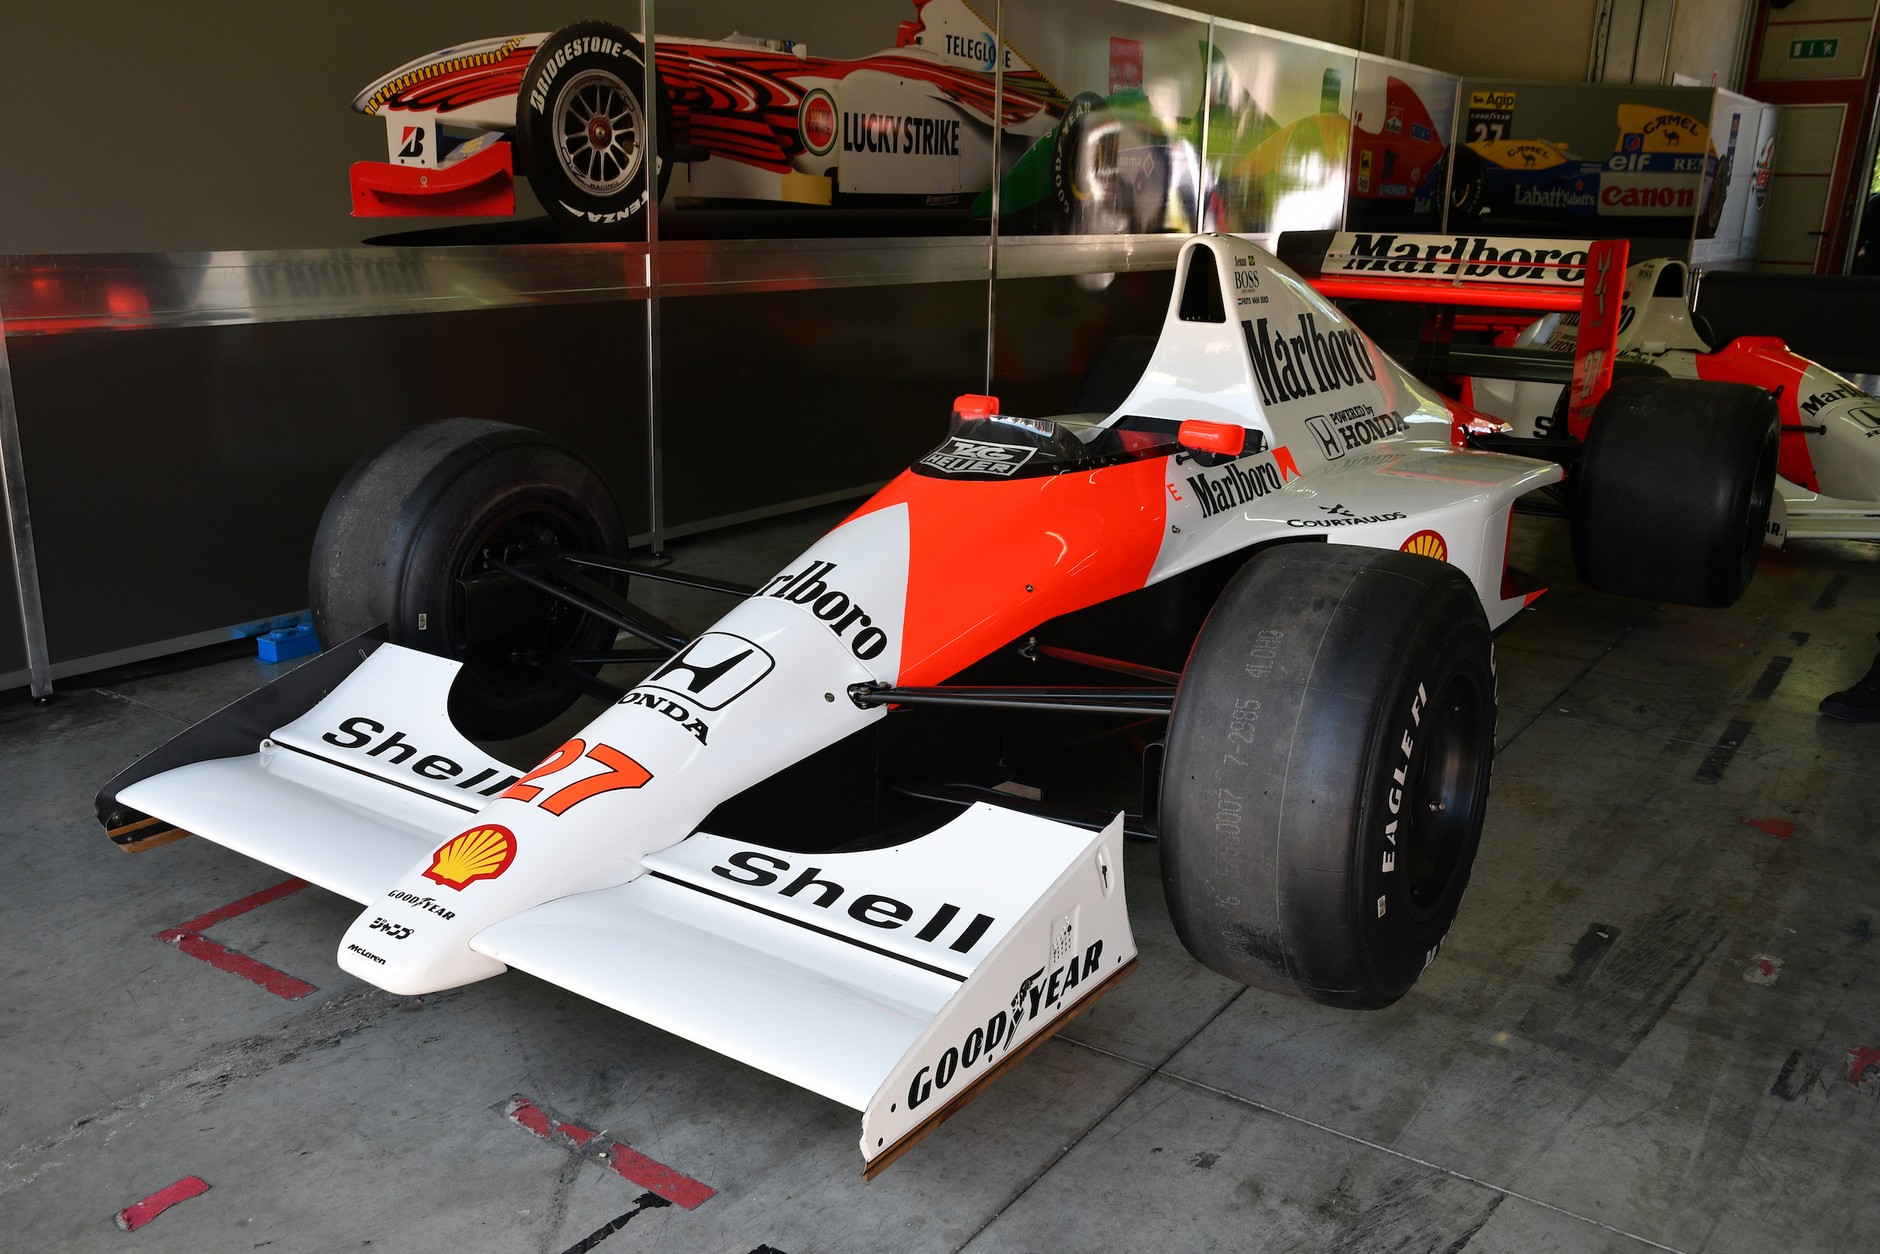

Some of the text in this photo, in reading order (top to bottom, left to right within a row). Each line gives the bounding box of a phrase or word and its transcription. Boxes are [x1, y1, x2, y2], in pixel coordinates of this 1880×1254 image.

[946, 34, 1011, 68] TELEGLOE
[530, 36, 622, 116] BRIDGESTONE
[1486, 93, 1513, 108] Agip
[843, 112, 960, 156] LUCKY STRIKE
[1475, 123, 1504, 142] 27
[1643, 114, 1699, 137] CAMEL
[1507, 145, 1550, 159] CAMEL
[1608, 153, 1651, 171] elf
[1602, 186, 1695, 208] Canon
[1342, 234, 1588, 282] Marlboro
[1234, 270, 1260, 289] BOSS
[1241, 312, 1376, 407] Marlboro
[1329, 404, 1375, 425] POWERED by
[1338, 411, 1410, 450] HONDA
[926, 454, 1011, 473] HEUER
[1187, 459, 1282, 519] Marlboro
[1287, 511, 1407, 528] COURTAULDS
[618, 692, 709, 747] ONDA
[498, 738, 655, 818] 27
[1381, 728, 1415, 873] EAGLE
[388, 889, 457, 921] GOODYEAR
[711, 851, 996, 954] Shell
[369, 917, 415, 940] ジャンプ
[347, 943, 387, 966] McLaren
[907, 939, 1104, 1111] GOODYEAR
